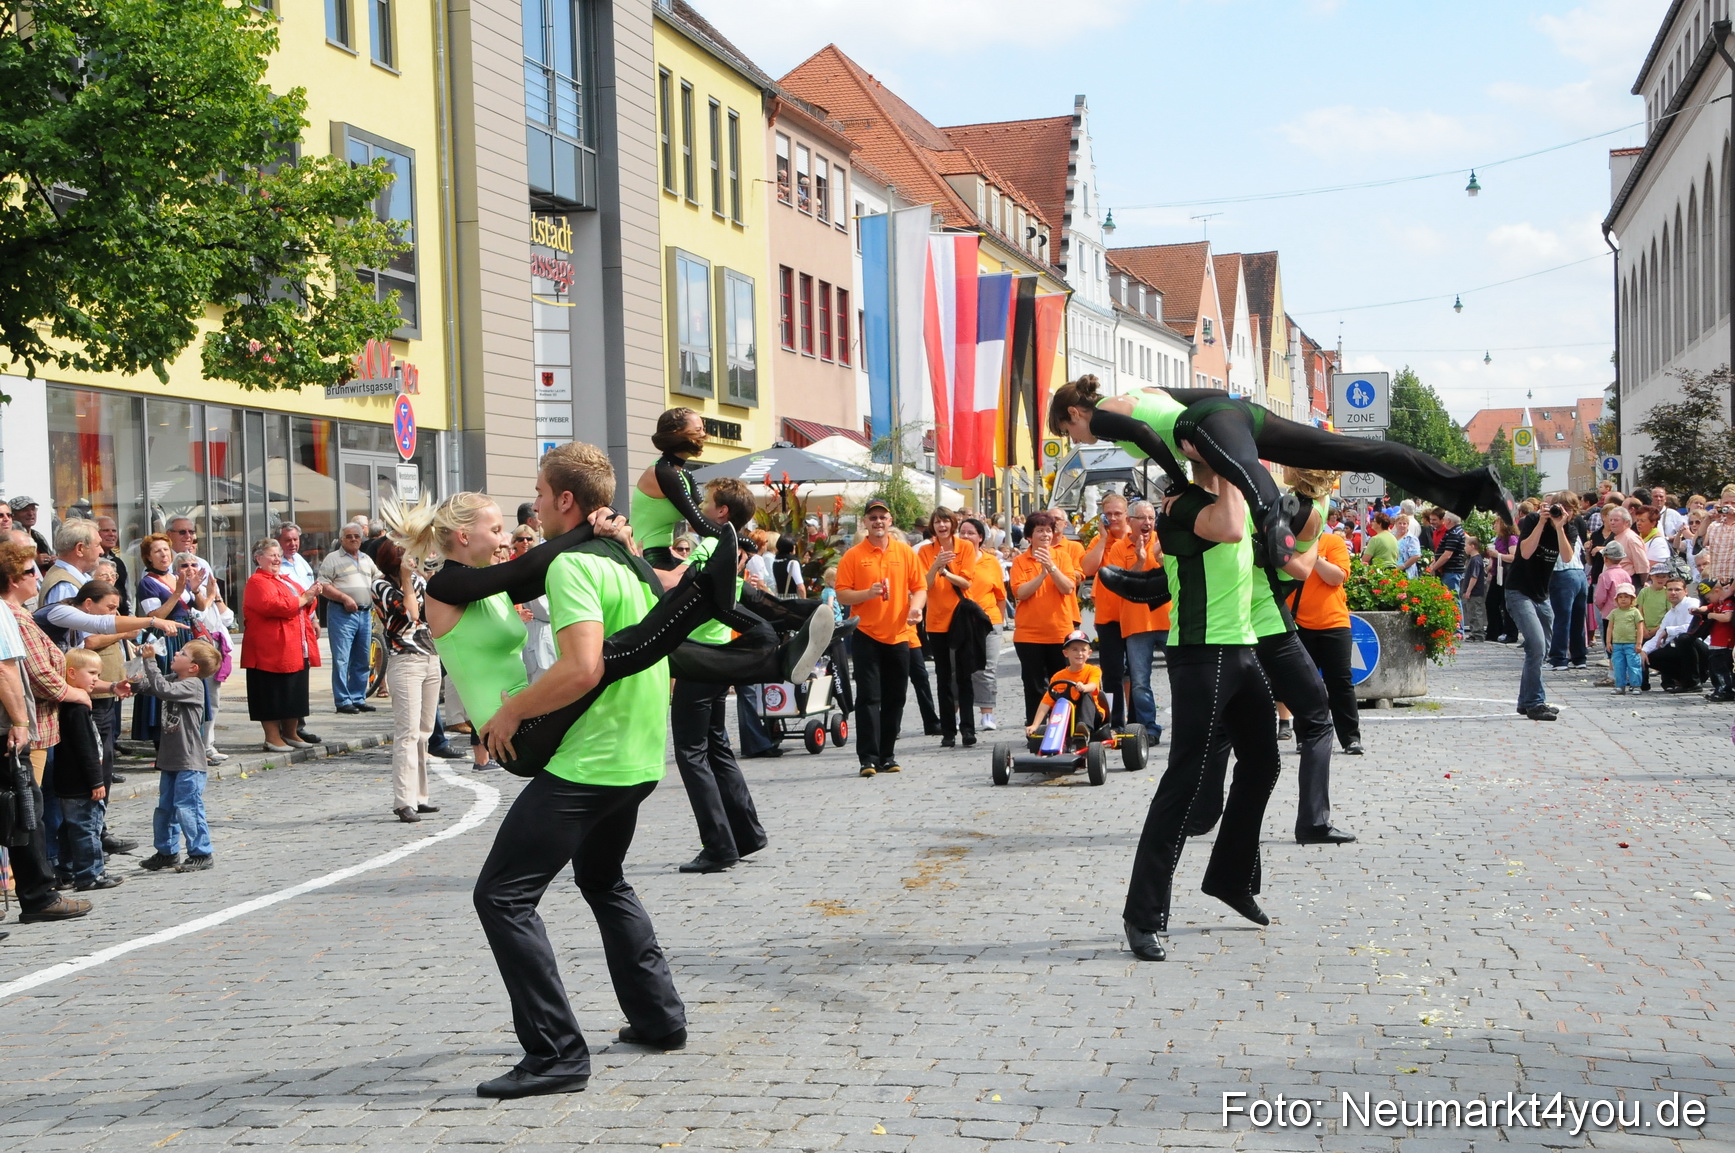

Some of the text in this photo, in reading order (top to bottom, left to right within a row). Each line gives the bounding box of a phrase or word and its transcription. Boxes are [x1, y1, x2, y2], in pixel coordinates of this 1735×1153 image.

[531, 212, 574, 254] tstadt
[531, 253, 575, 292] assage
[326, 382, 393, 396] Brunnwirtsgasse
[1347, 413, 1375, 423] ZONE
[1355, 485, 1370, 493] frei
